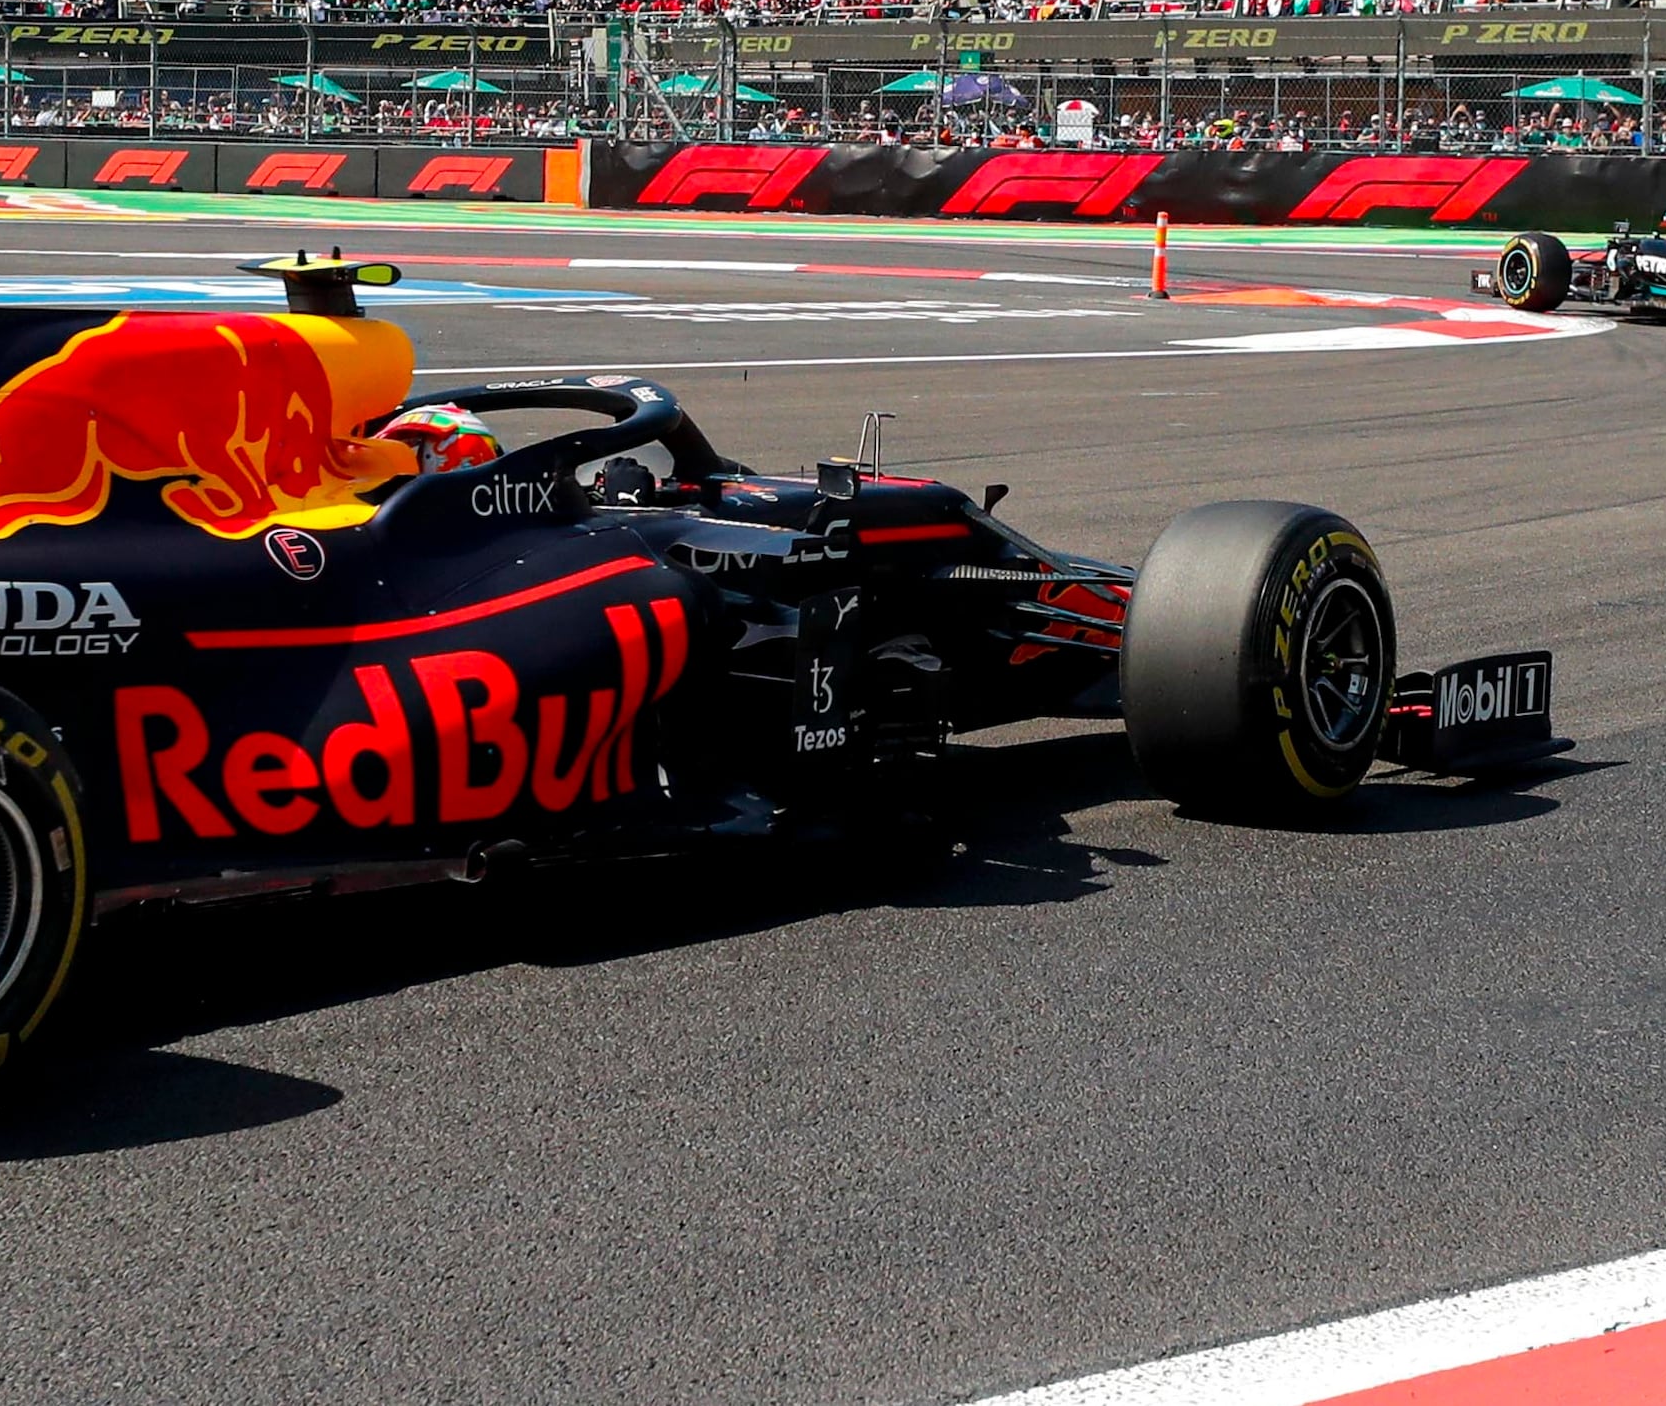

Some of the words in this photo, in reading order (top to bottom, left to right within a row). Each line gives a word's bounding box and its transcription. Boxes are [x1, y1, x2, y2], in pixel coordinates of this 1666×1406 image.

[10, 26, 40, 42] P
[49, 26, 175, 45] ZERO
[371, 33, 403, 50] P
[410, 34, 528, 53] ZERO
[1184, 27, 1278, 49] ZERO
[1441, 24, 1470, 44] P
[1477, 21, 1591, 44] ZERO
[485, 377, 564, 390] ORACLE
[470, 471, 556, 517] citrix
[1274, 535, 1329, 668] ZERO
[1273, 686, 1292, 720] P
[1438, 664, 1513, 730] Mobil
[794, 723, 847, 752] Tezos
